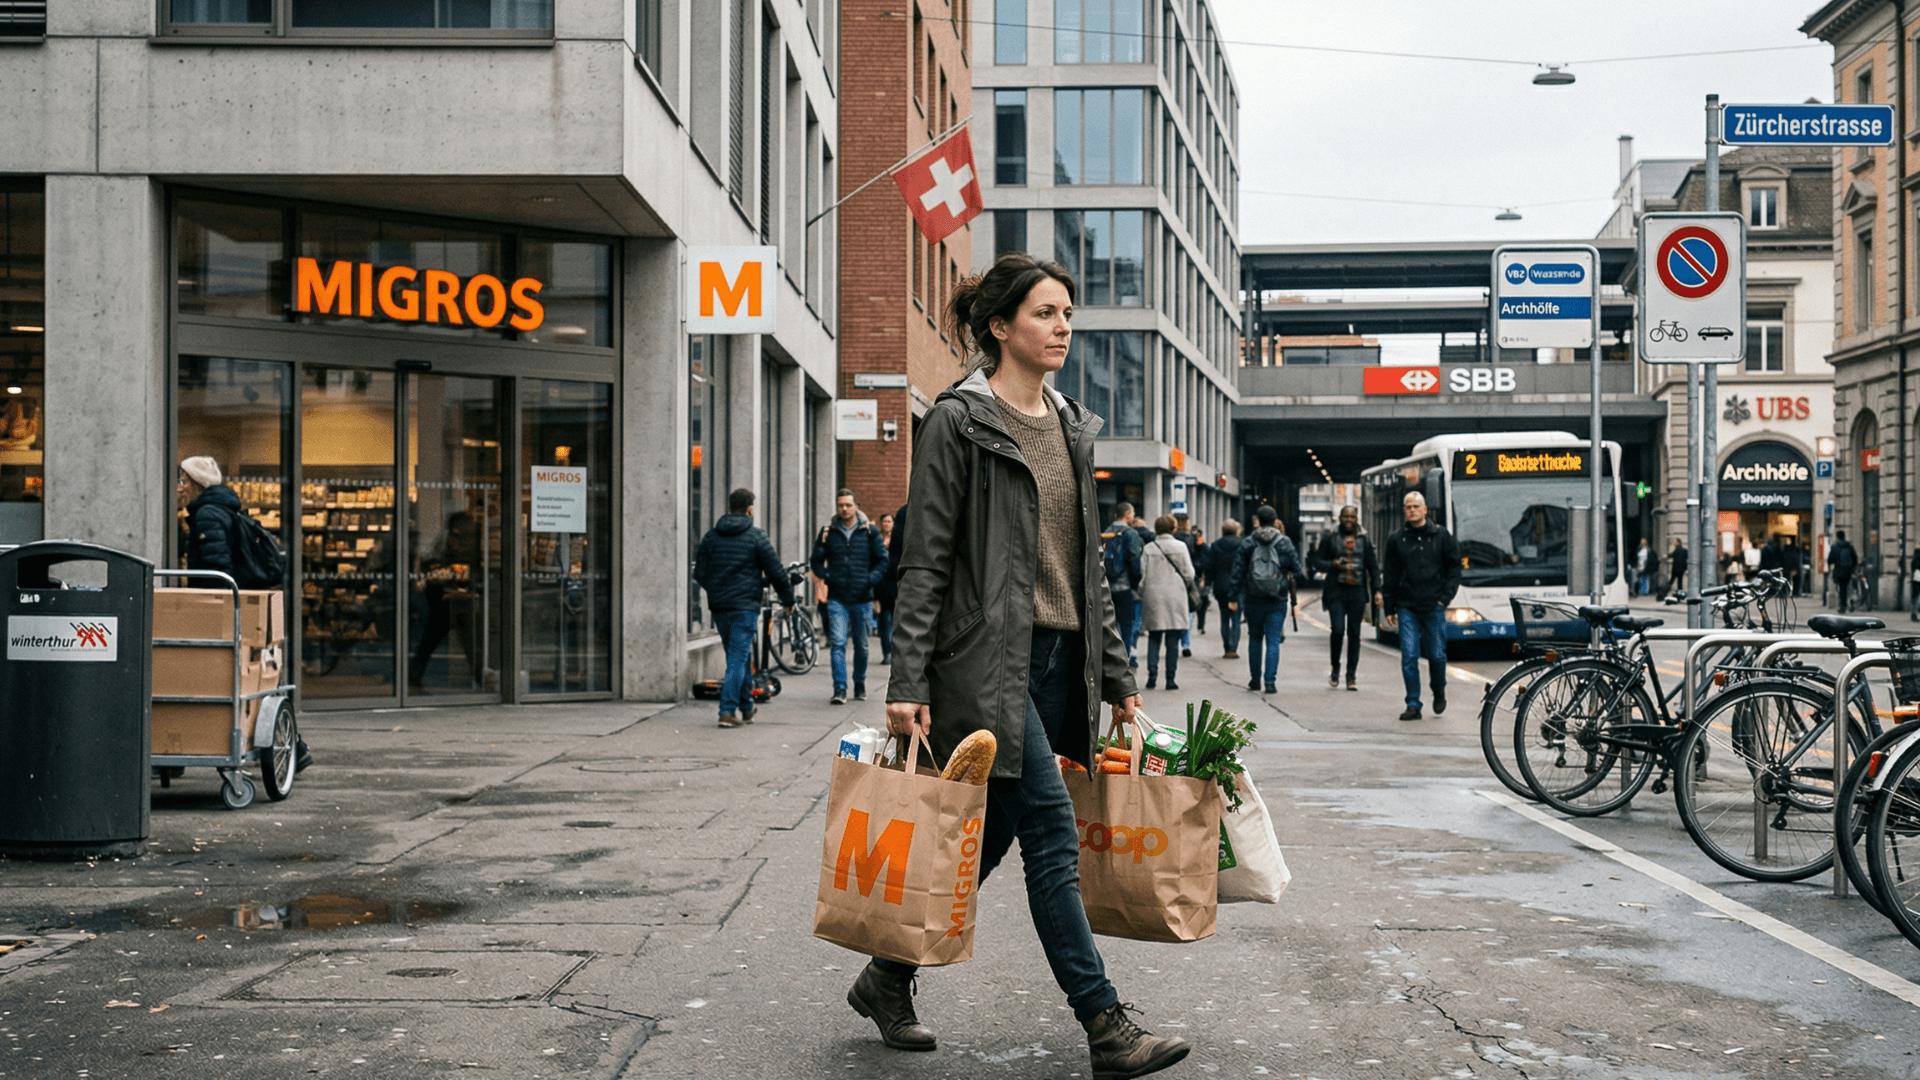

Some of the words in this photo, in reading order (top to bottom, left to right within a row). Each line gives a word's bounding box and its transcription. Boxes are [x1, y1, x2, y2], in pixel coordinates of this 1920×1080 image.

[1734, 113, 1883, 136] Zürcherstrasse
[297, 257, 545, 331] MIGROS
[699, 261, 762, 317] M
[1449, 367, 1517, 393] SBB
[1756, 396, 1810, 420] UBS
[1465, 453, 1477, 475] 2
[1722, 462, 1809, 481] Archhöfe
[1820, 463, 1829, 475] P
[537, 471, 581, 483] MIGROS
[1740, 492, 1790, 506] Shopping
[11, 635, 77, 648] winterthur
[833, 808, 915, 906] M
[946, 817, 982, 938] MIGROS
